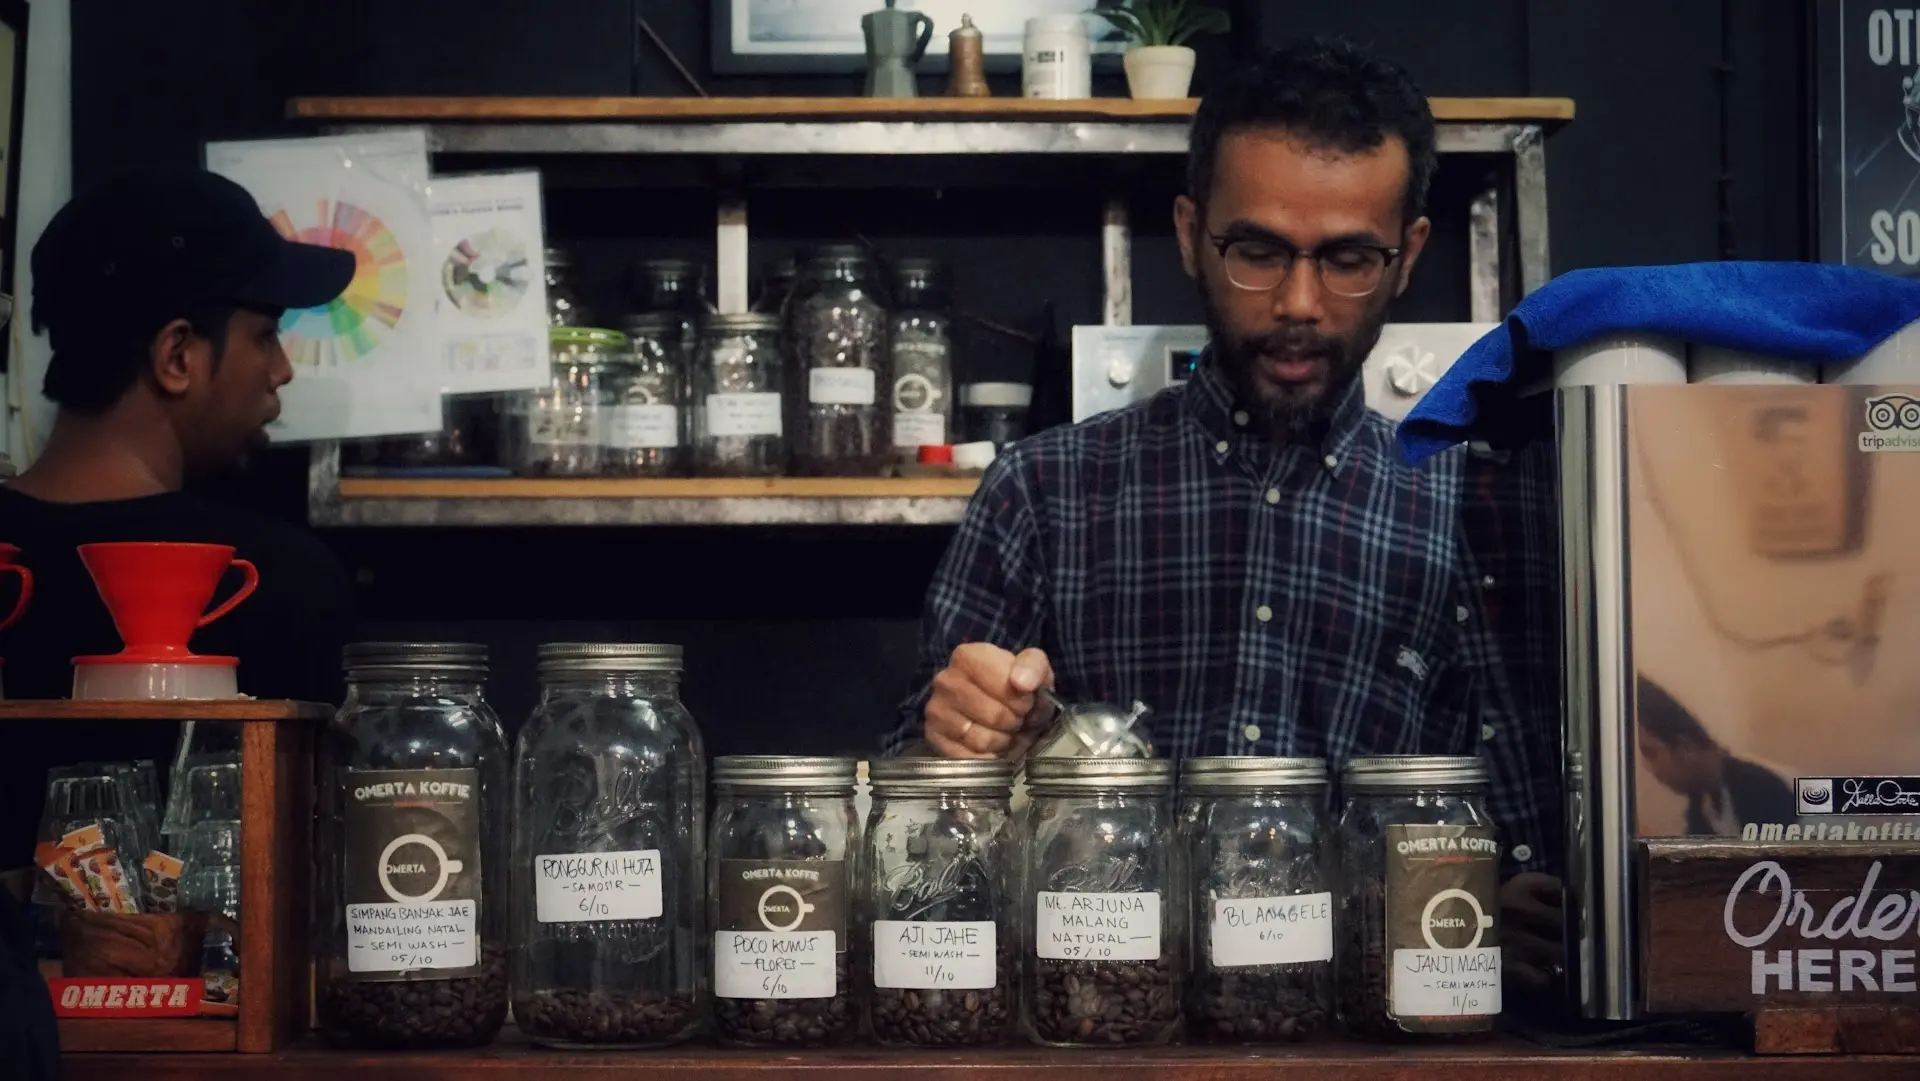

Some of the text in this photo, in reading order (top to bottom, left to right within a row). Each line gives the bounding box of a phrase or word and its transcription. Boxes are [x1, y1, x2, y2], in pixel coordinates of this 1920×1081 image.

[355, 781, 470, 799] OMERTA KOFFIE
[1397, 838, 1457, 854] OMERTA
[386, 863, 426, 874] OMERTA
[543, 857, 604, 879] RONGGUR
[742, 868, 782, 880] OMERTA
[572, 880, 624, 892] SAMOSIR
[579, 895, 609, 916] 6/10
[763, 905, 790, 913] OMERTA
[1072, 896, 1144, 913] ARJUNA
[350, 906, 469, 920] SIMPANG BANYAK JAE
[1062, 914, 1128, 929] MALANG
[1429, 918, 1466, 929] OMERTA
[353, 924, 465, 936] MANDAILING NATAL
[899, 926, 979, 946] AJI JAHE
[1052, 931, 1126, 944] NATURAL
[1260, 930, 1283, 940] 6/10
[371, 942, 402, 950] SEMI
[733, 935, 768, 954] POCO
[391, 954, 433, 966] 05/10
[1406, 953, 1497, 973] JANJI MARIA
[925, 965, 954, 983] 11/10
[1751, 949, 1917, 994] HERE
[762, 974, 788, 997] 6/10
[61, 984, 190, 1009] OMERTA
[1452, 993, 1478, 1014] 11/10
